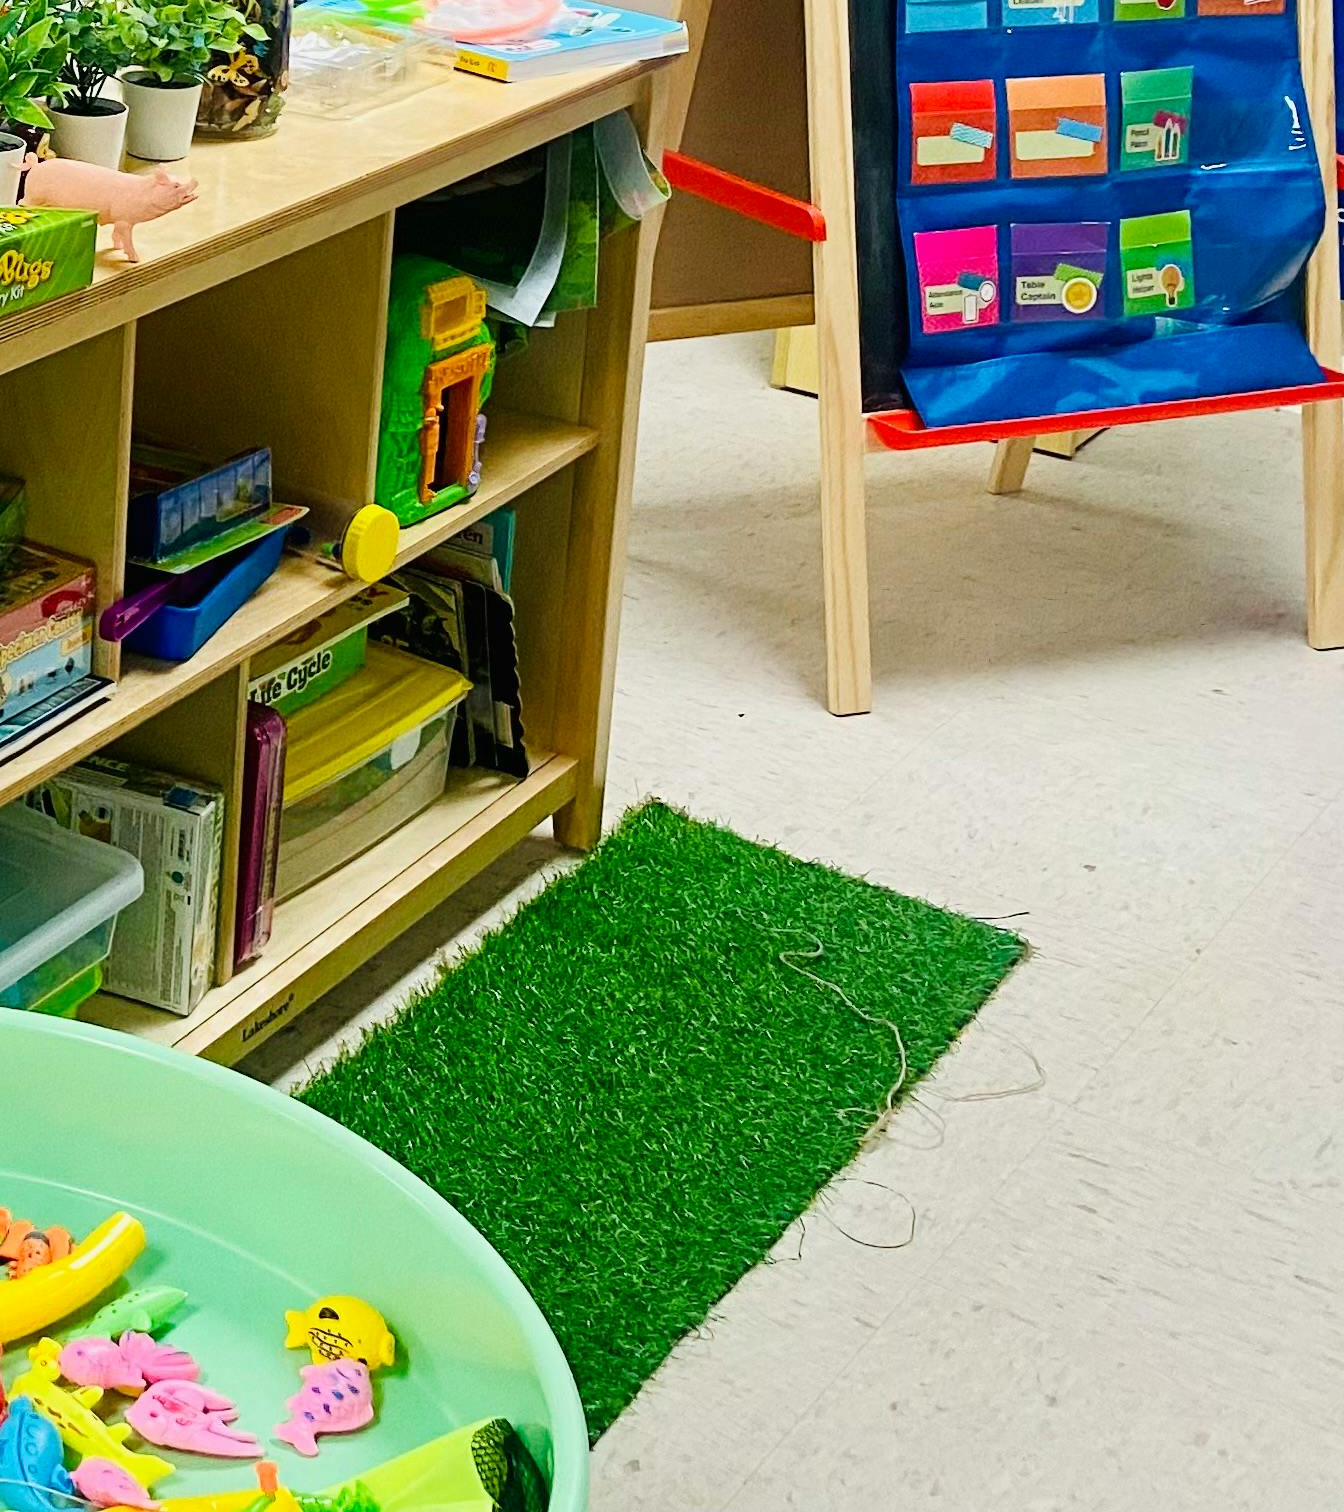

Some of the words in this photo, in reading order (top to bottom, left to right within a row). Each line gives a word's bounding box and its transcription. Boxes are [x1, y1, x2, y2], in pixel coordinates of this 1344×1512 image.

[0, 221, 18, 234] Kit
[1021, 281, 1046, 289] Table
[9, 284, 25, 302] Kit
[1020, 292, 1056, 301] Captain
[286, 649, 331, 694] Cycle
[242, 1000, 290, 1042] Lakeshore
